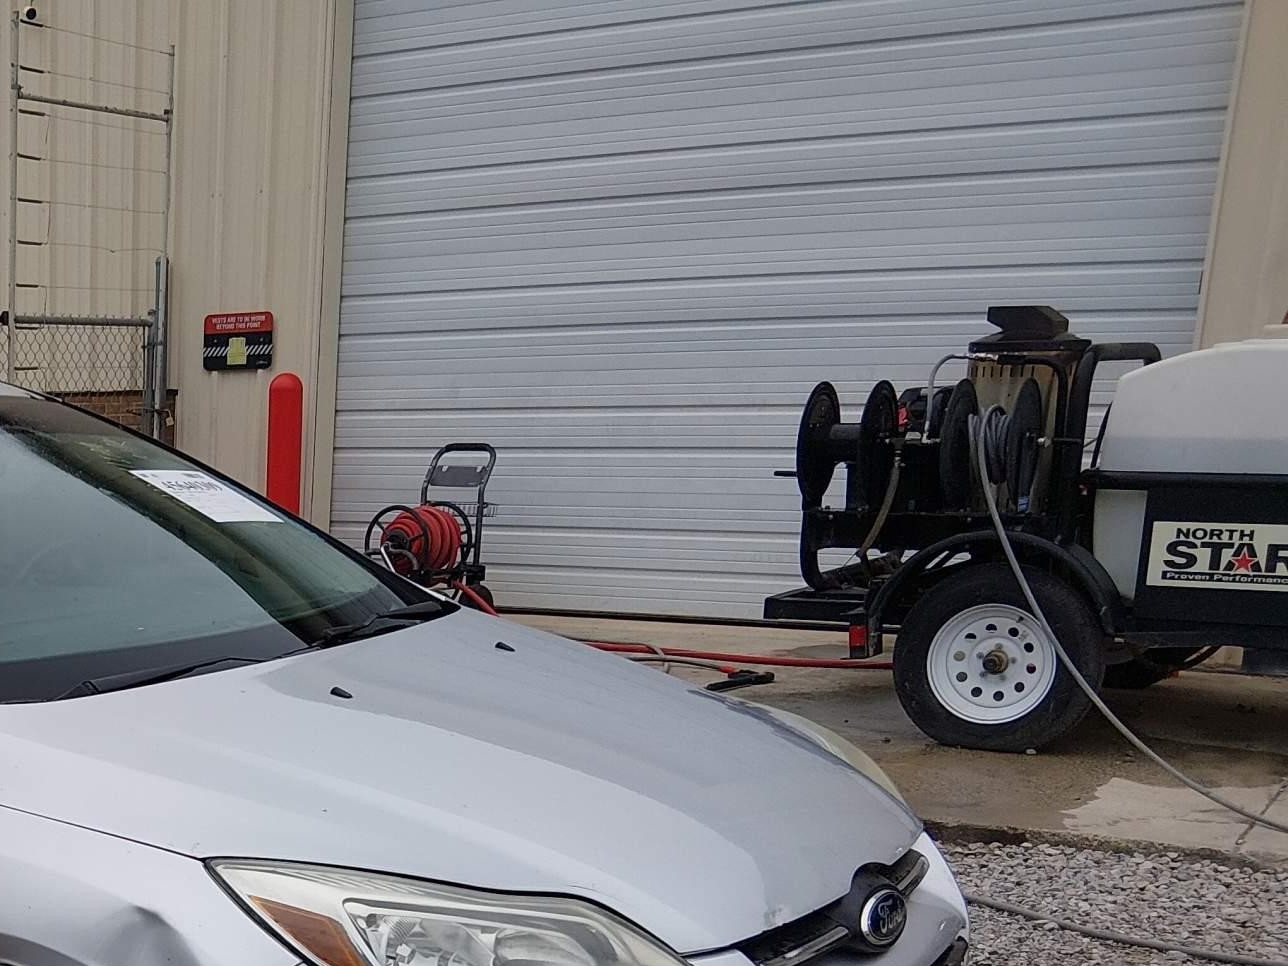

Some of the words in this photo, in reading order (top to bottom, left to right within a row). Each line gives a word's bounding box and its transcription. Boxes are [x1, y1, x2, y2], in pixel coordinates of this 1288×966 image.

[1175, 527, 1255, 542] NORTH
[1163, 540, 1288, 574] STAR
[1166, 571, 1210, 581] Proven
[878, 899, 904, 934] Ford
